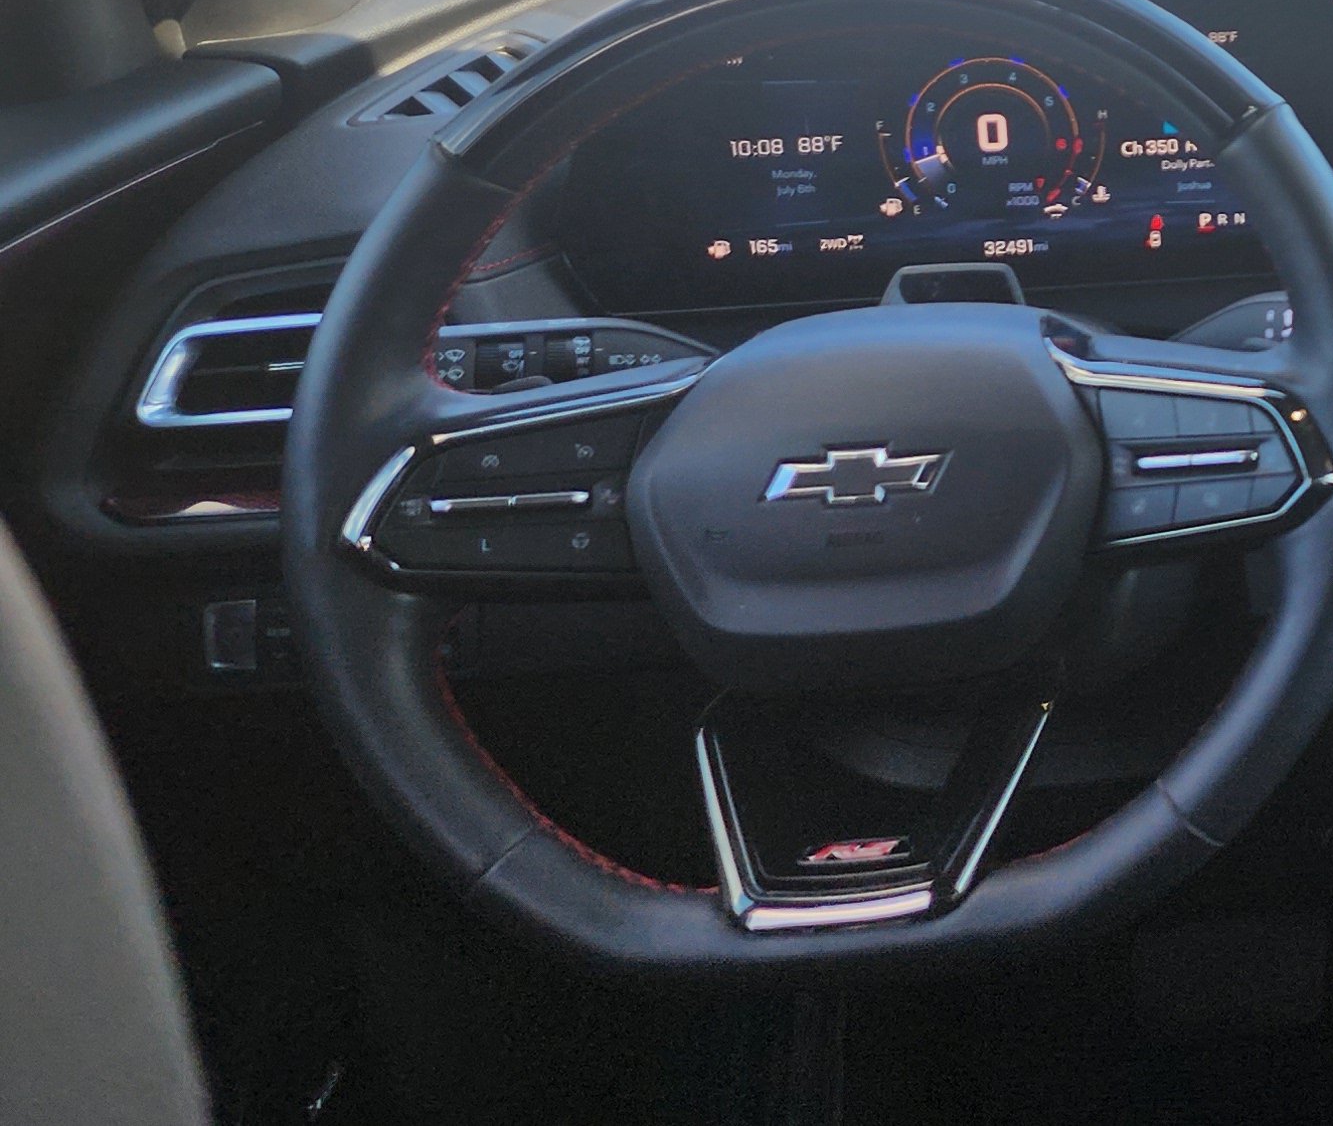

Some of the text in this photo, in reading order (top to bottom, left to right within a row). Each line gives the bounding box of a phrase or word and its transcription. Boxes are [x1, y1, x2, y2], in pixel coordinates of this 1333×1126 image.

[960, 74, 969, 85] 3
[1008, 72, 1018, 83] 4
[926, 101, 937, 113] 2
[976, 113, 1009, 153] 0
[730, 135, 844, 158] 10:08 88°F
[1120, 140, 1144, 158] Ch
[1145, 138, 1180, 156] 350
[981, 155, 1009, 166] MPH
[1161, 158, 1188, 172] Dolly
[1008, 181, 1034, 193] RPM
[1006, 195, 1040, 207] x1000
[1199, 212, 1246, 228] P R N
[820, 237, 848, 252] 2WD
